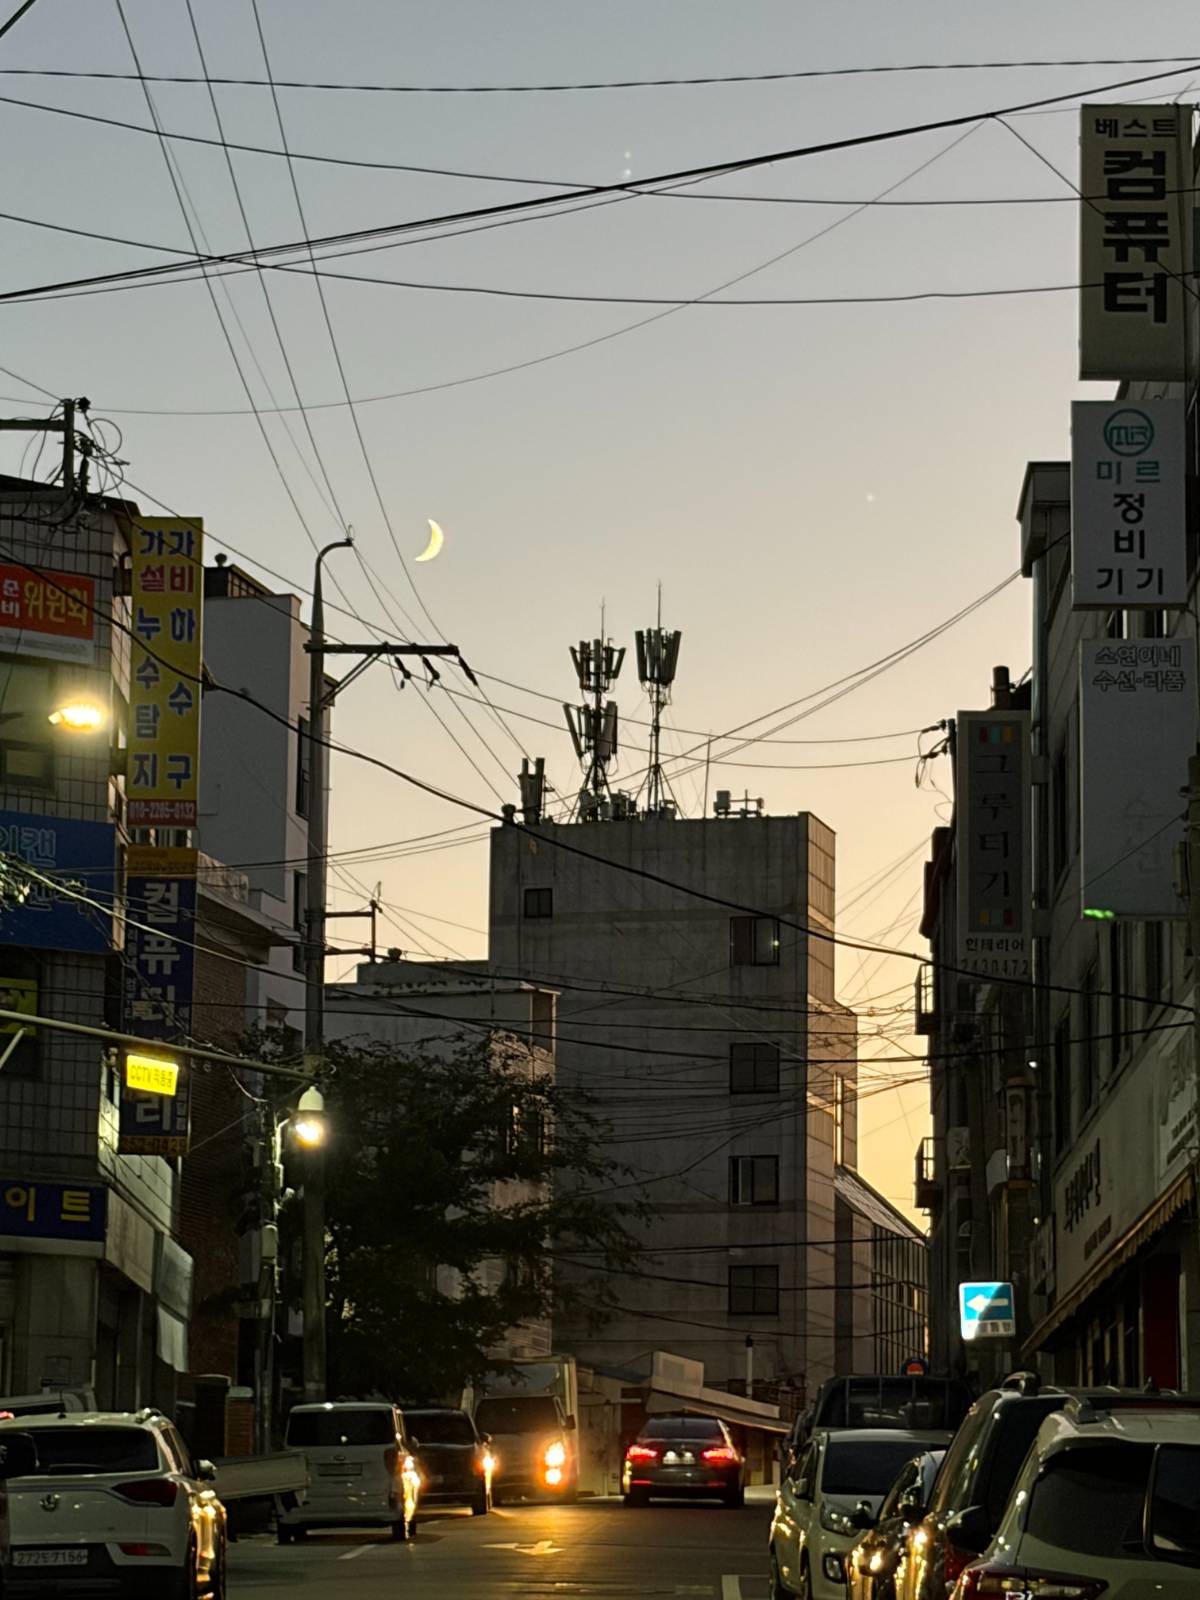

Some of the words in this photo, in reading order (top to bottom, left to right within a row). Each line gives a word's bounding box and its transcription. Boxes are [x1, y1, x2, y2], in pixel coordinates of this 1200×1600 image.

[1095, 118, 1177, 138] 베스트
[1103, 150, 1169, 323] 컴퓨터
[1096, 460, 1160, 485] 미르
[140, 529, 195, 558] 가가
[1113, 493, 1145, 559] 정비
[140, 564, 194, 593] 설비
[1096, 568, 1163, 595] 기기
[23, 579, 90, 626] 위원회
[1095, 645, 1181, 667] 소연이네
[133, 607, 161, 788] 누수탐지
[167, 607, 195, 790] 하수구
[975, 754, 1013, 897] 그루터기
[139, 881, 181, 1027] 컴퓨터
